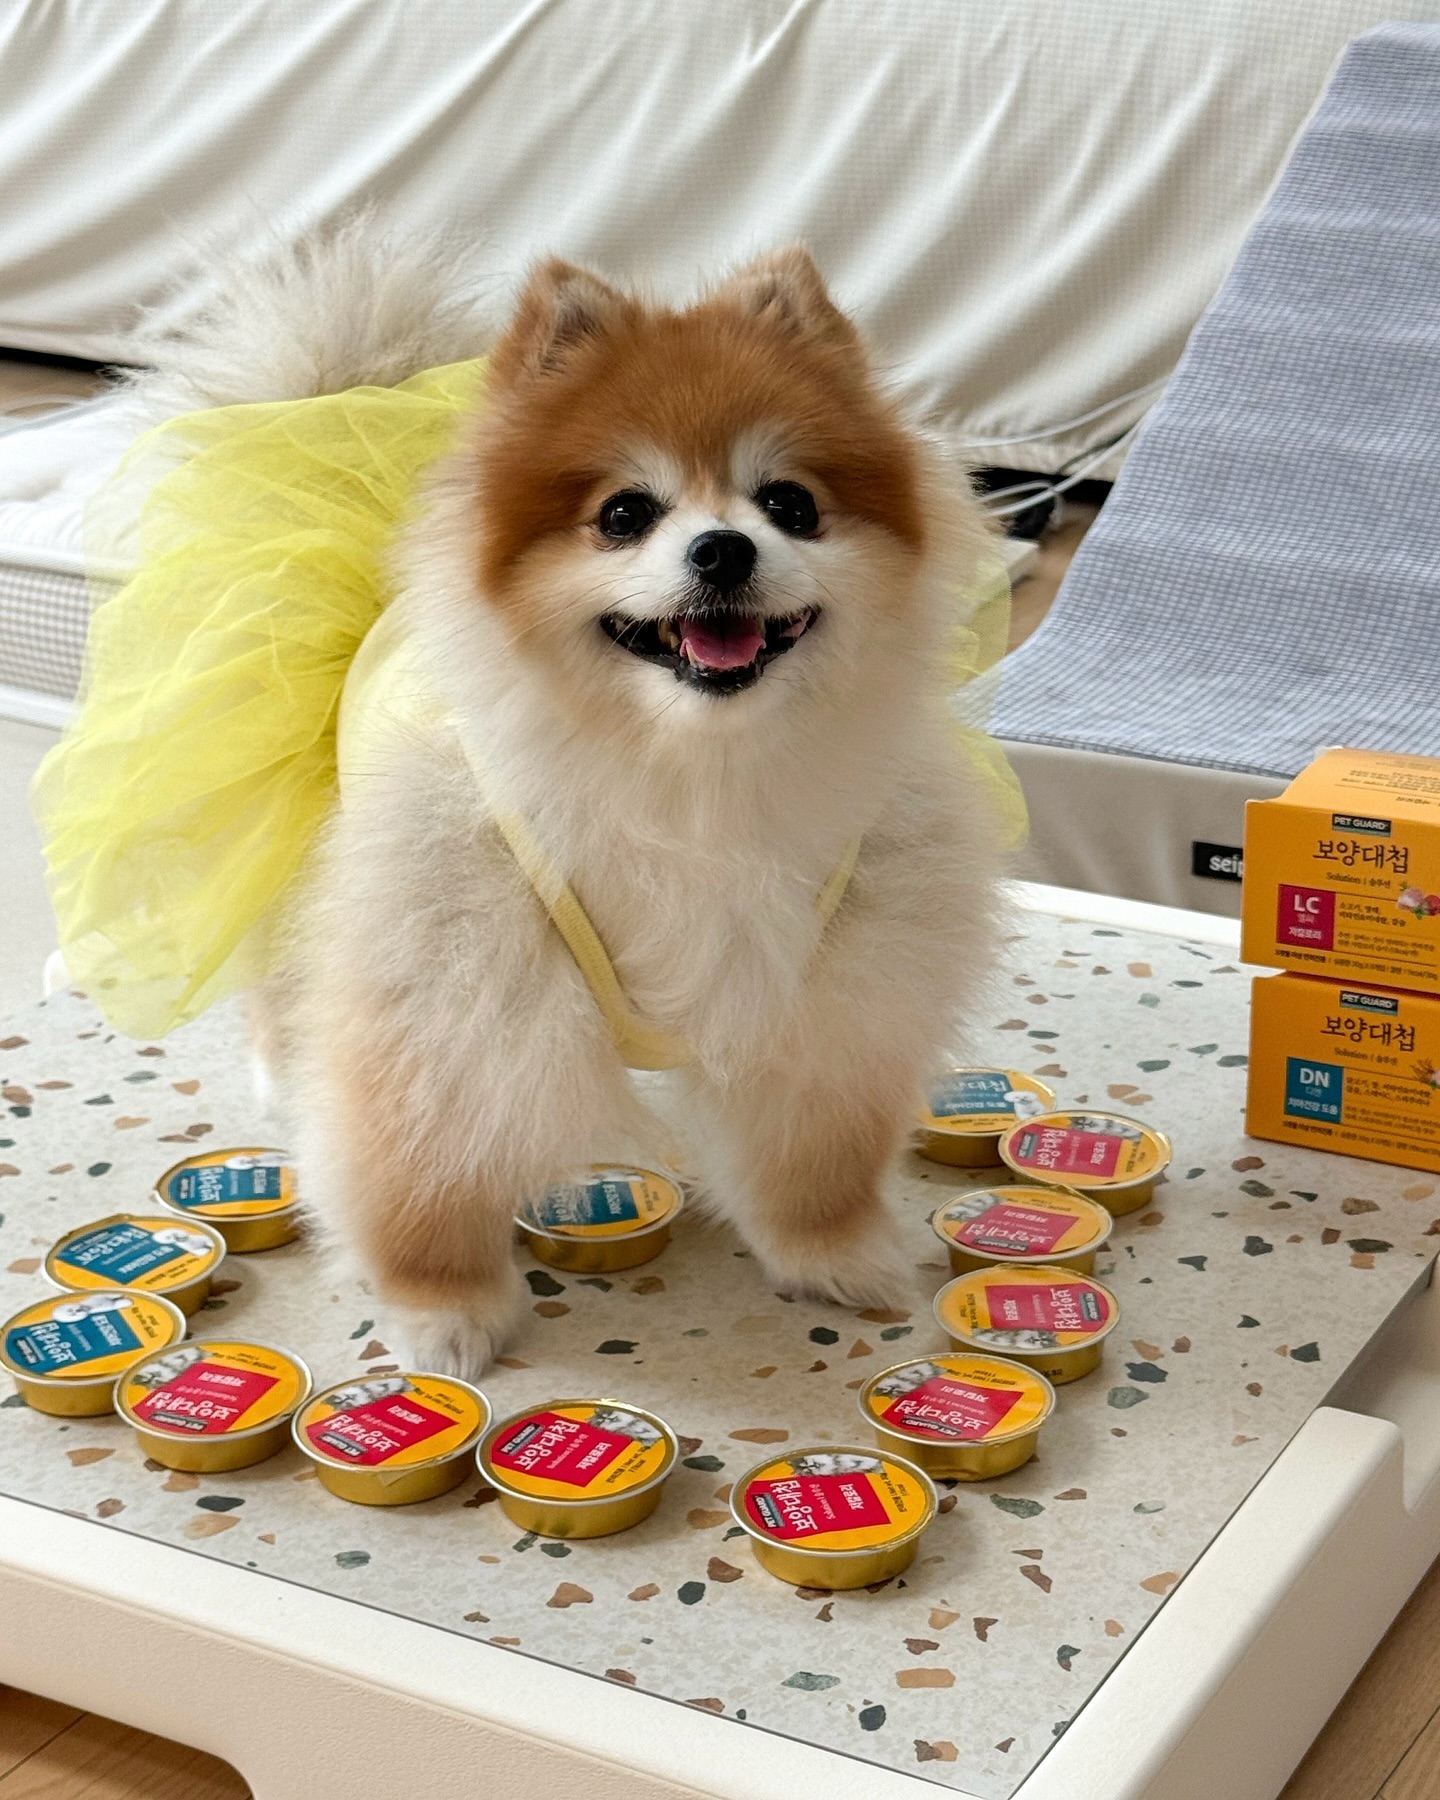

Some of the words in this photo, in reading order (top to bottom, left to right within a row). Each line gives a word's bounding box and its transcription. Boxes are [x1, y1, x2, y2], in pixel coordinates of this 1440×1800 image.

[1334, 816, 1352, 826] PET
[1353, 819, 1386, 830] GUARD
[1312, 840, 1408, 874] 보양대첩
[1326, 872, 1361, 884] Solution
[1369, 878, 1391, 889] 솔루션
[1294, 894, 1321, 914] LC
[1288, 926, 1322, 940] 저칼로리
[1342, 993, 1359, 1004] PET
[1360, 997, 1394, 1009] GUARD
[1320, 1016, 1415, 1052] 보양대첩
[1334, 1047, 1369, 1060] Solution
[1300, 1067, 1330, 1088] DN
[1036, 1129, 1068, 1168] 보양대첩
[1003, 1210, 1048, 1224] 저칼로리
[964, 1223, 1053, 1244] 보양대첩
[1049, 1288, 1082, 1329] 보양대첩
[29, 1323, 77, 1363] 보양대첩
[197, 1371, 247, 1387] 저칼로리
[940, 1385, 989, 1403] 저칼로리
[145, 1391, 239, 1420] 보양대첩
[387, 1405, 427, 1425] 저칼로리
[894, 1399, 990, 1431] 보양대첩
[323, 1414, 400, 1452] 보양대첩
[904, 1419, 939, 1432] GUARD
[941, 1427, 957, 1437] PET
[322, 1436, 347, 1451] GUARD
[501, 1440, 515, 1454] PET
[512, 1424, 537, 1444] GUARD
[514, 1419, 580, 1471] 보양대첩
[346, 1447, 361, 1457] PET
[575, 1442, 613, 1470] 저칼로리
[755, 1497, 771, 1517] GUARD
[770, 1480, 818, 1531] 보양대첩
[839, 1483, 864, 1511] 저칼로리
[764, 1516, 777, 1528] PET
